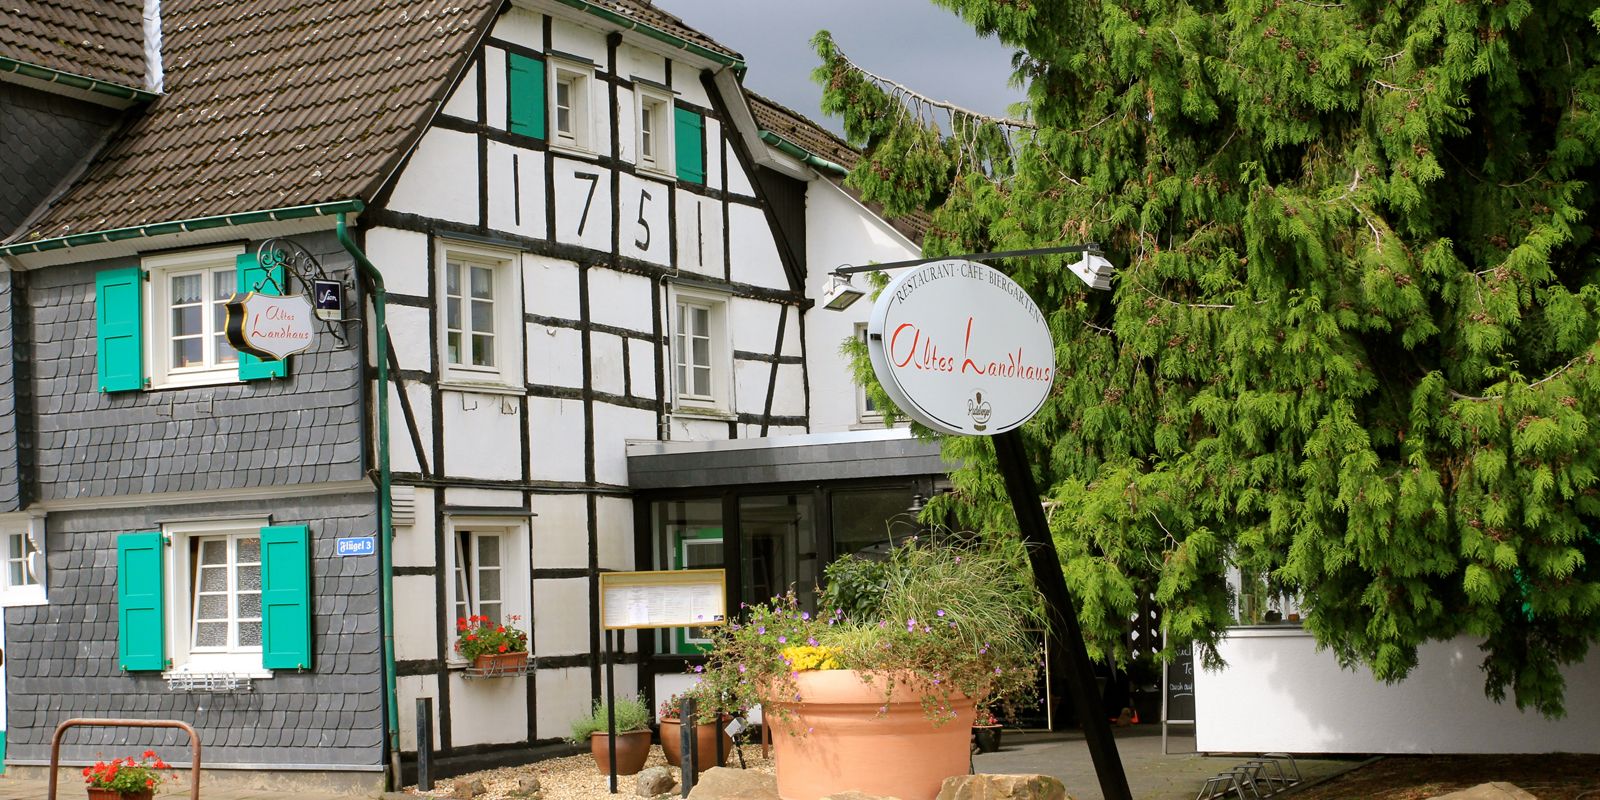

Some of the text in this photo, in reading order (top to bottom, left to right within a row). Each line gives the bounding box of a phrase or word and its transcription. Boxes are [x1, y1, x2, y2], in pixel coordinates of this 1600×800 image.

[896, 263, 955, 304] RESTAURANT
[989, 271, 1040, 323] BIERGARTEN
[251, 313, 309, 339] Landhaus
[265, 305, 295, 321] Altes
[890, 316, 1050, 382] Altes Landhaus
[340, 540, 371, 553] Flügel 3
